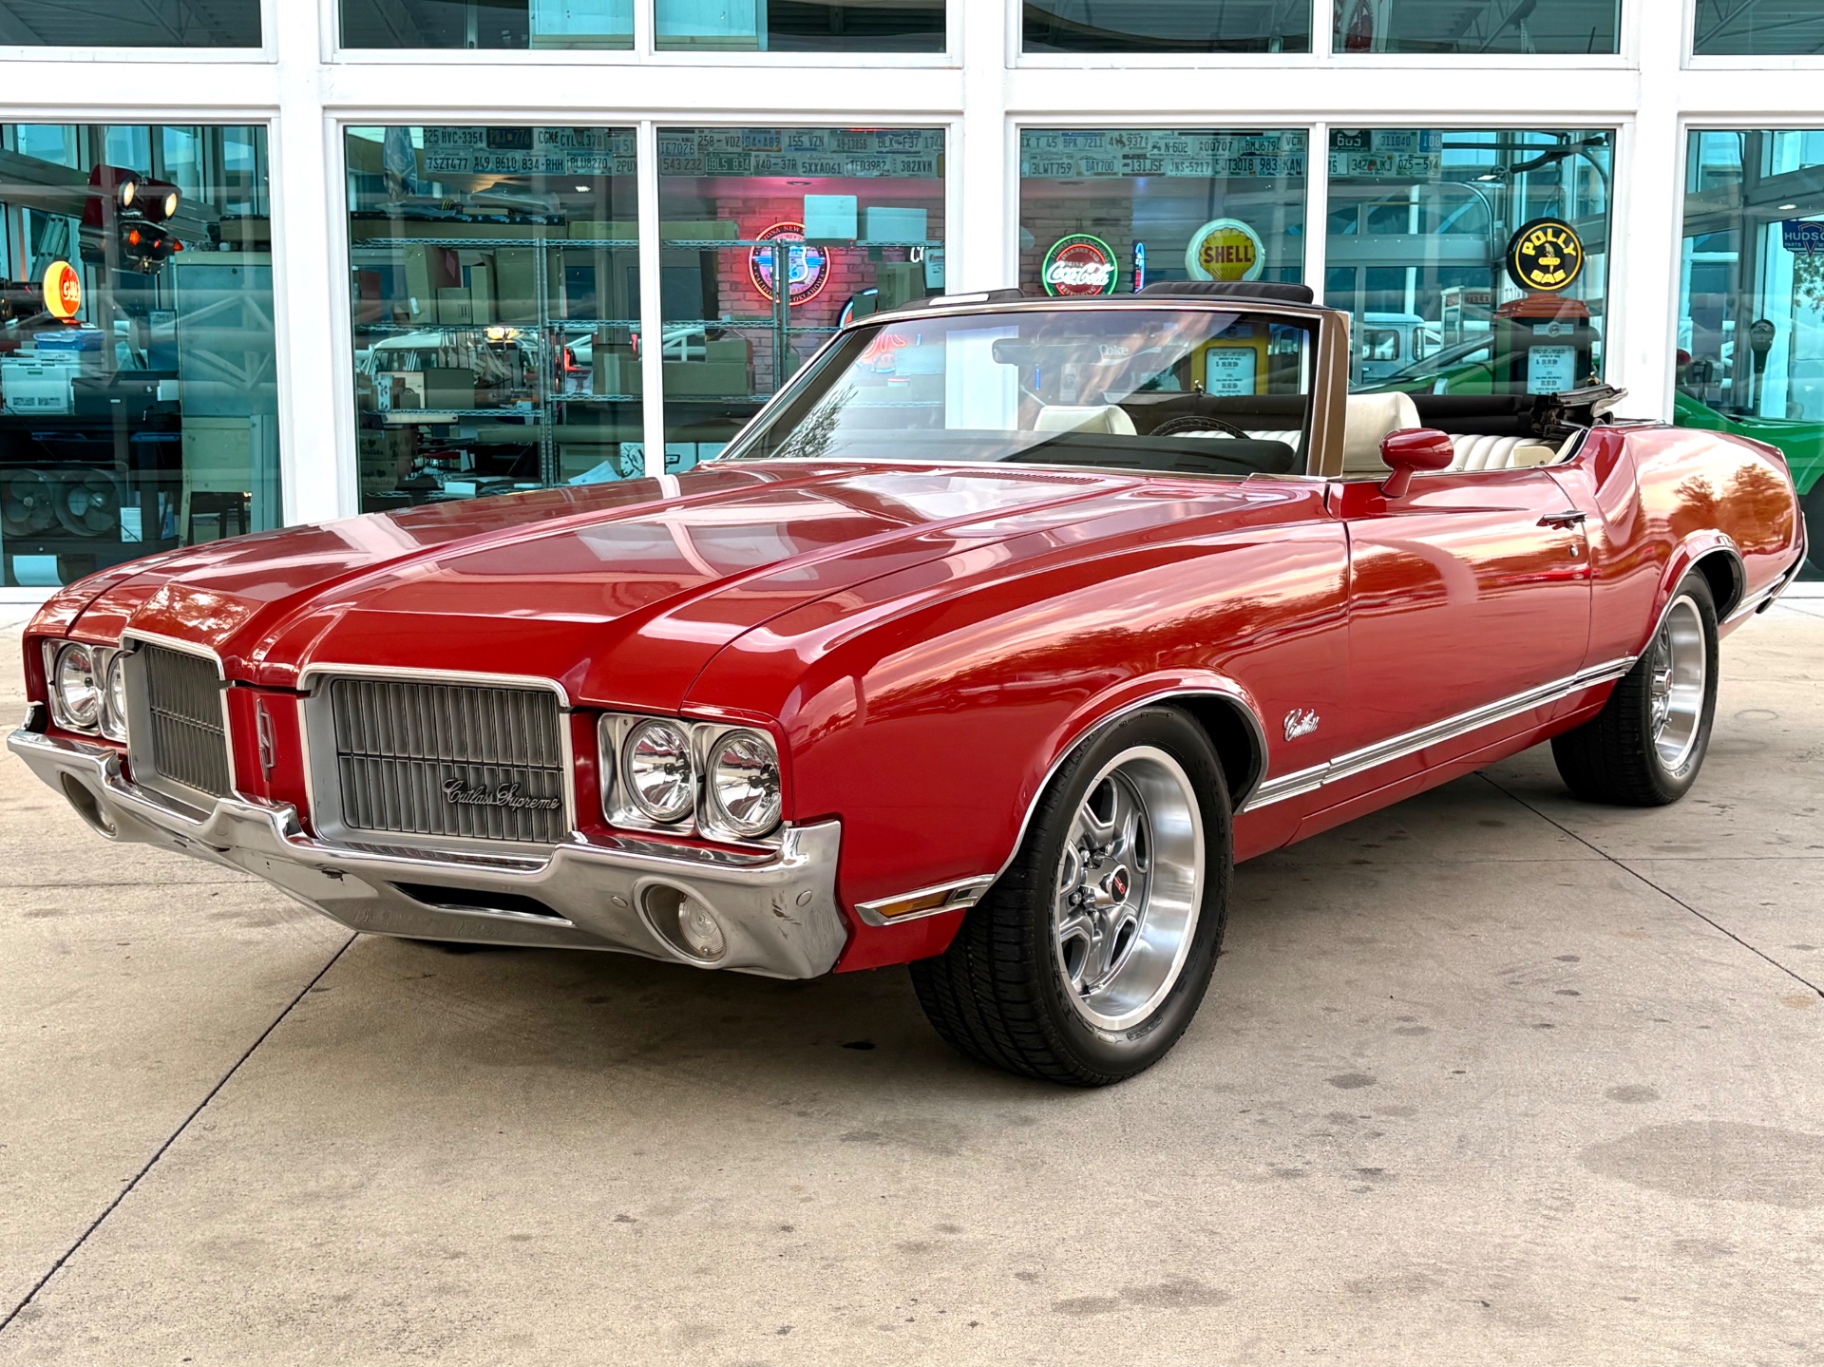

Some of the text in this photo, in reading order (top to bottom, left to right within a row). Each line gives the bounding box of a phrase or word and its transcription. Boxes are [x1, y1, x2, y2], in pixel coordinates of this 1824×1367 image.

[521, 158, 564, 171] 834-RHH
[663, 158, 703, 171] 543 232
[1031, 162, 1073, 175] 3LWT759
[1259, 158, 1303, 171] 983 KAN
[783, 225, 801, 234] NEW
[1521, 228, 1577, 257] POLLY
[1203, 245, 1252, 264] SHELL
[1530, 269, 1567, 284] GAS
[793, 274, 826, 302] OKLAHOMA
[443, 778, 562, 812] Cutlass Supreme
